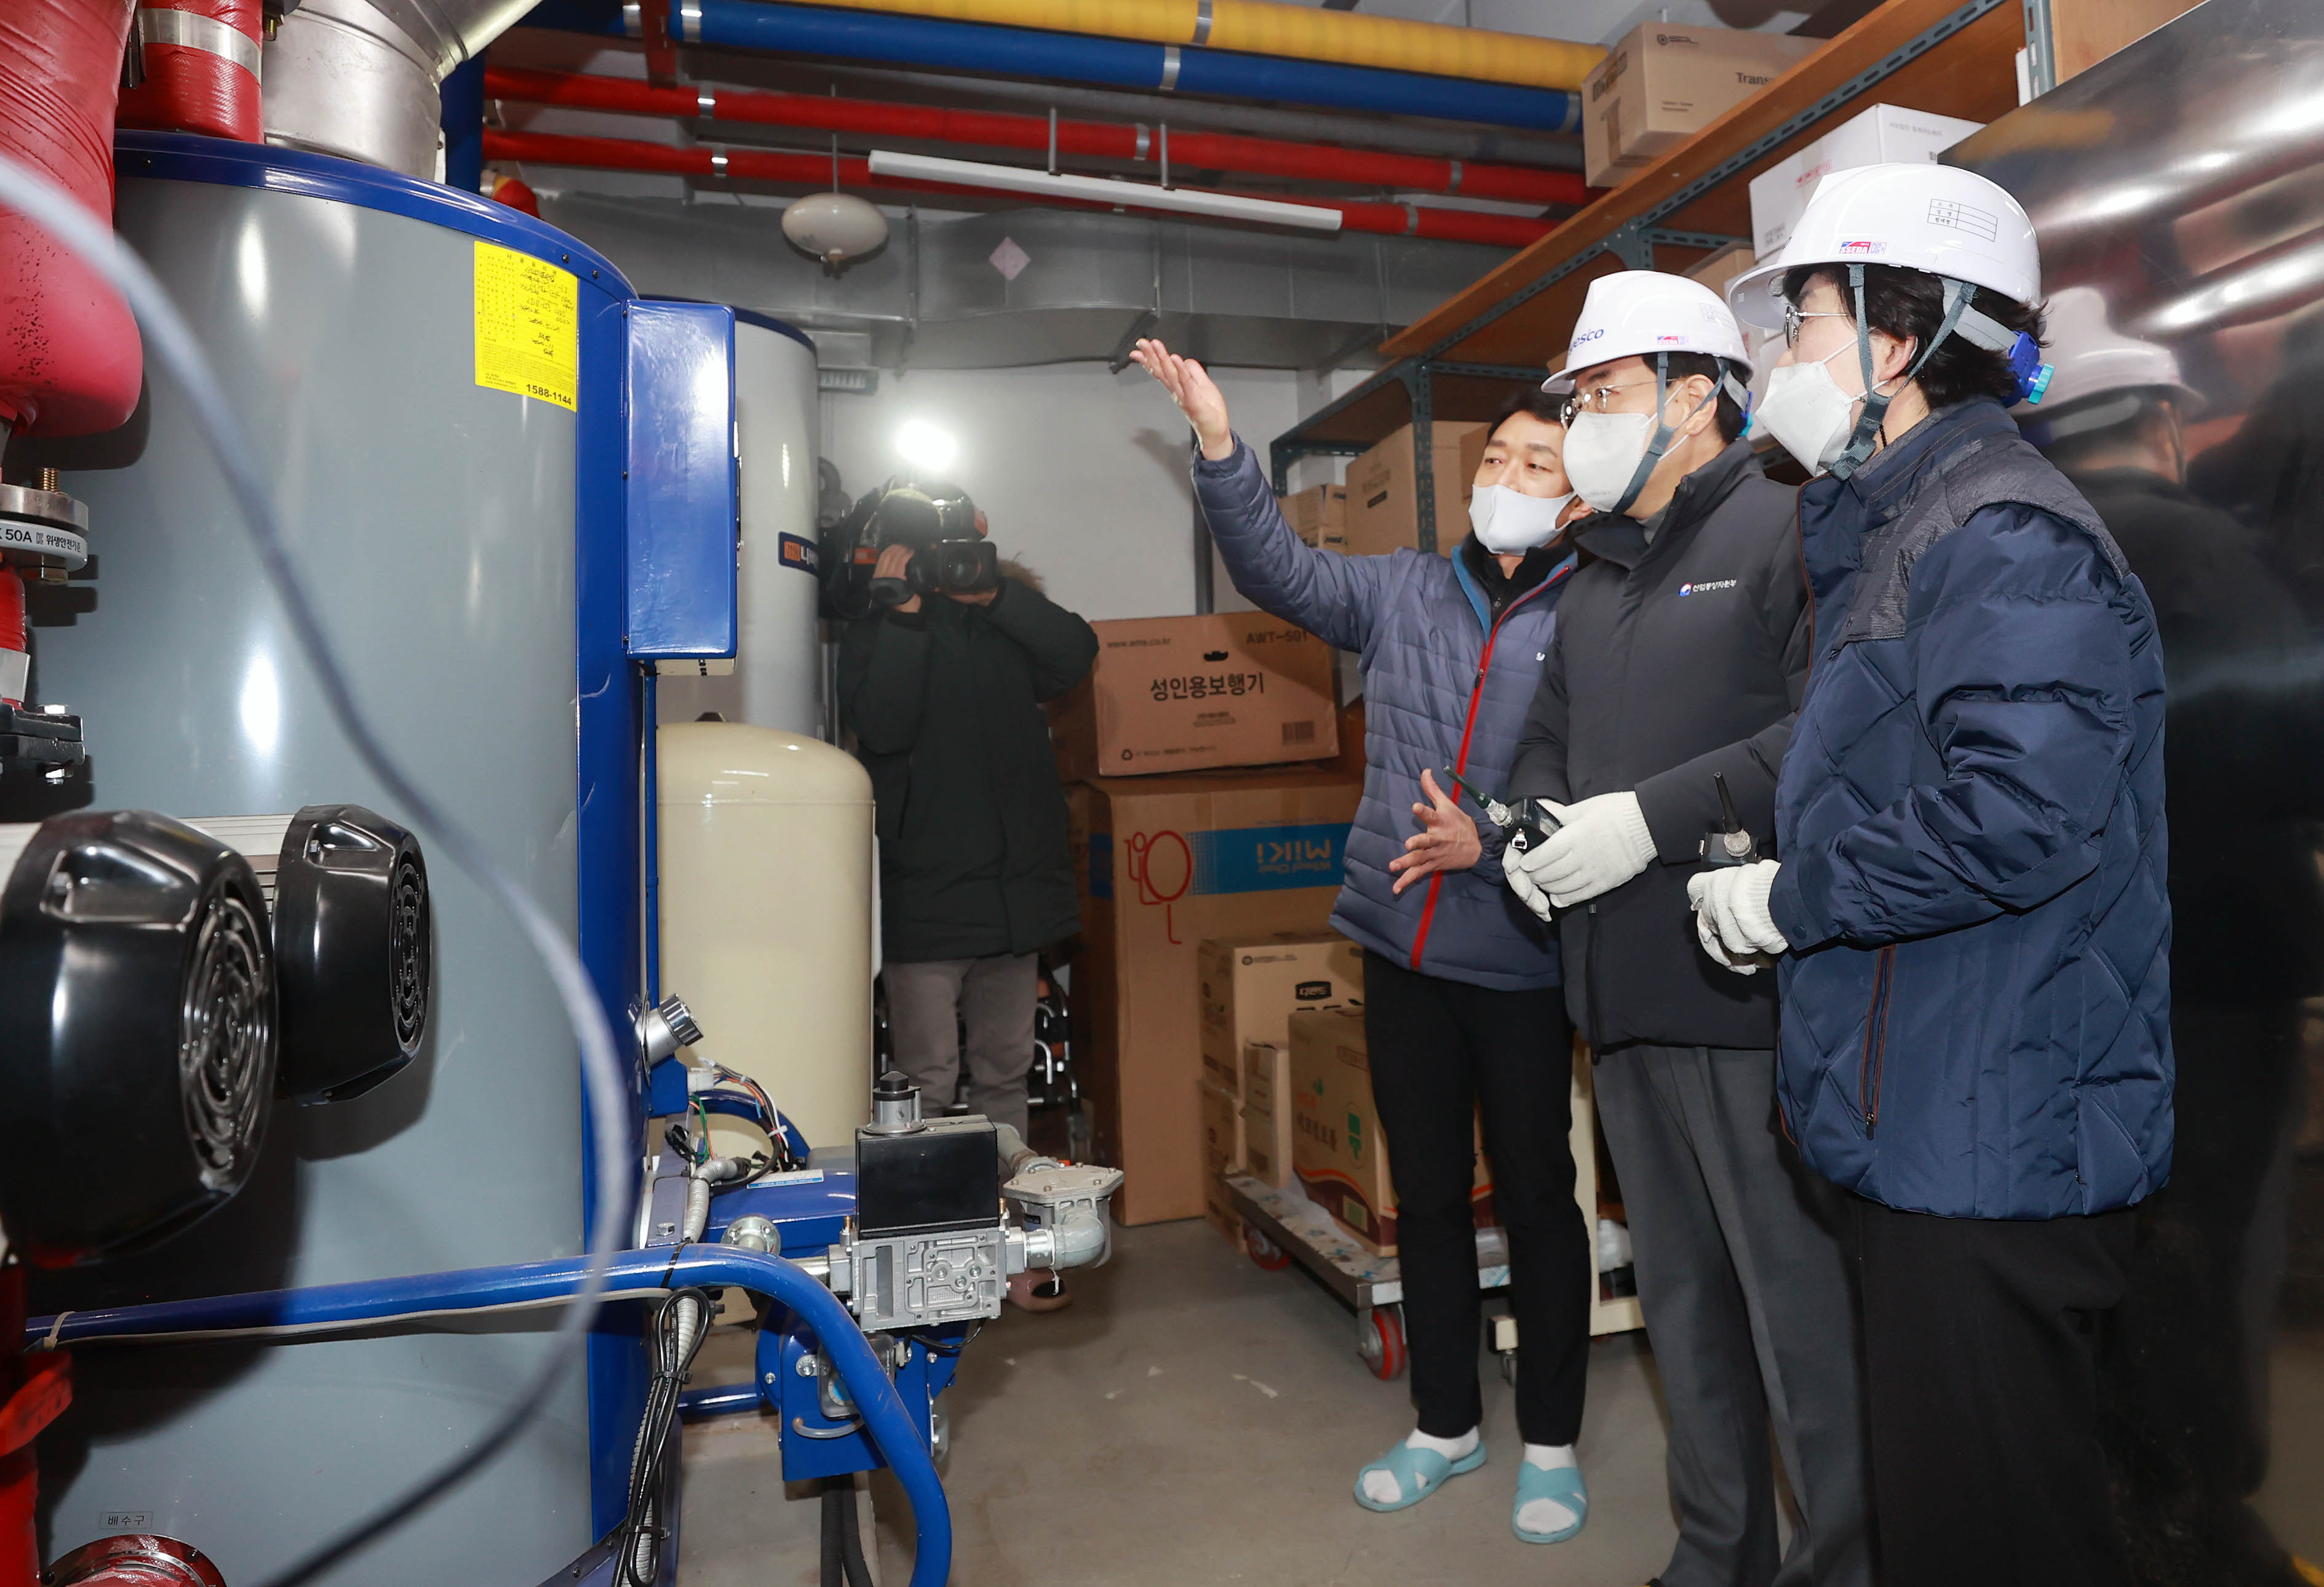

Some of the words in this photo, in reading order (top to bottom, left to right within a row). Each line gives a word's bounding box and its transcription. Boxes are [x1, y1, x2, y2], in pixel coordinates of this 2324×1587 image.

[1735, 71, 1774, 86] Trans
[527, 383, 571, 405] 1588-1144
[6, 528, 32, 543] 50A
[46, 535, 81, 552] 위생안전기준
[1692, 579, 1737, 592] 산업통상자원부
[1150, 672, 1265, 701] 성인용보행기
[108, 1515, 145, 1525] 배수구
